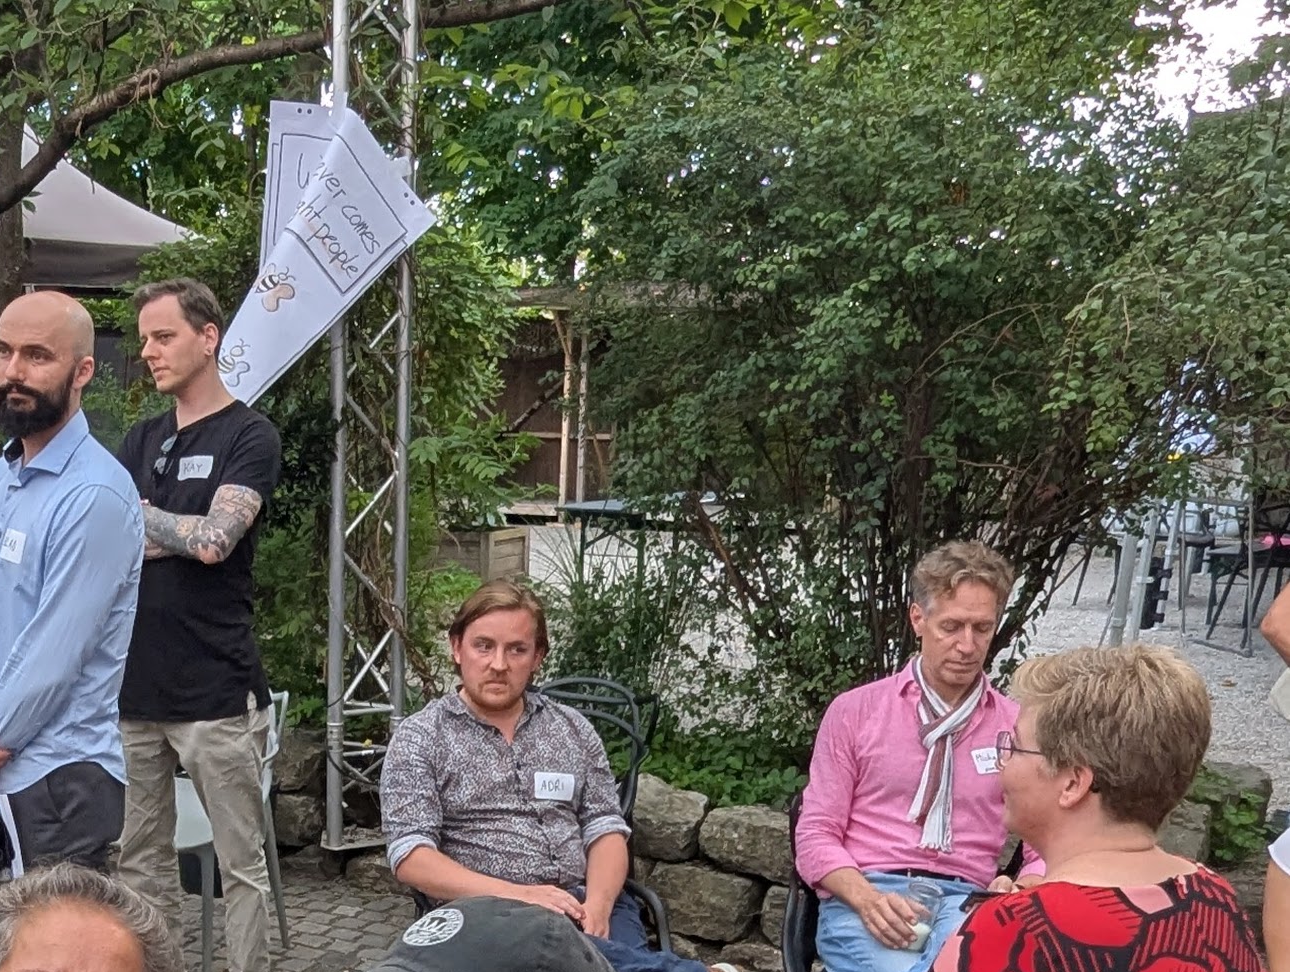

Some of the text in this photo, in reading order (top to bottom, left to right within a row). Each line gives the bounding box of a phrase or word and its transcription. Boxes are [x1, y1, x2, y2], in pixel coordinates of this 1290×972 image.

[341, 205, 380, 254] comes
[306, 223, 359, 279] people
[183, 463, 203, 475] KAY
[540, 779, 565, 792] ADRI
